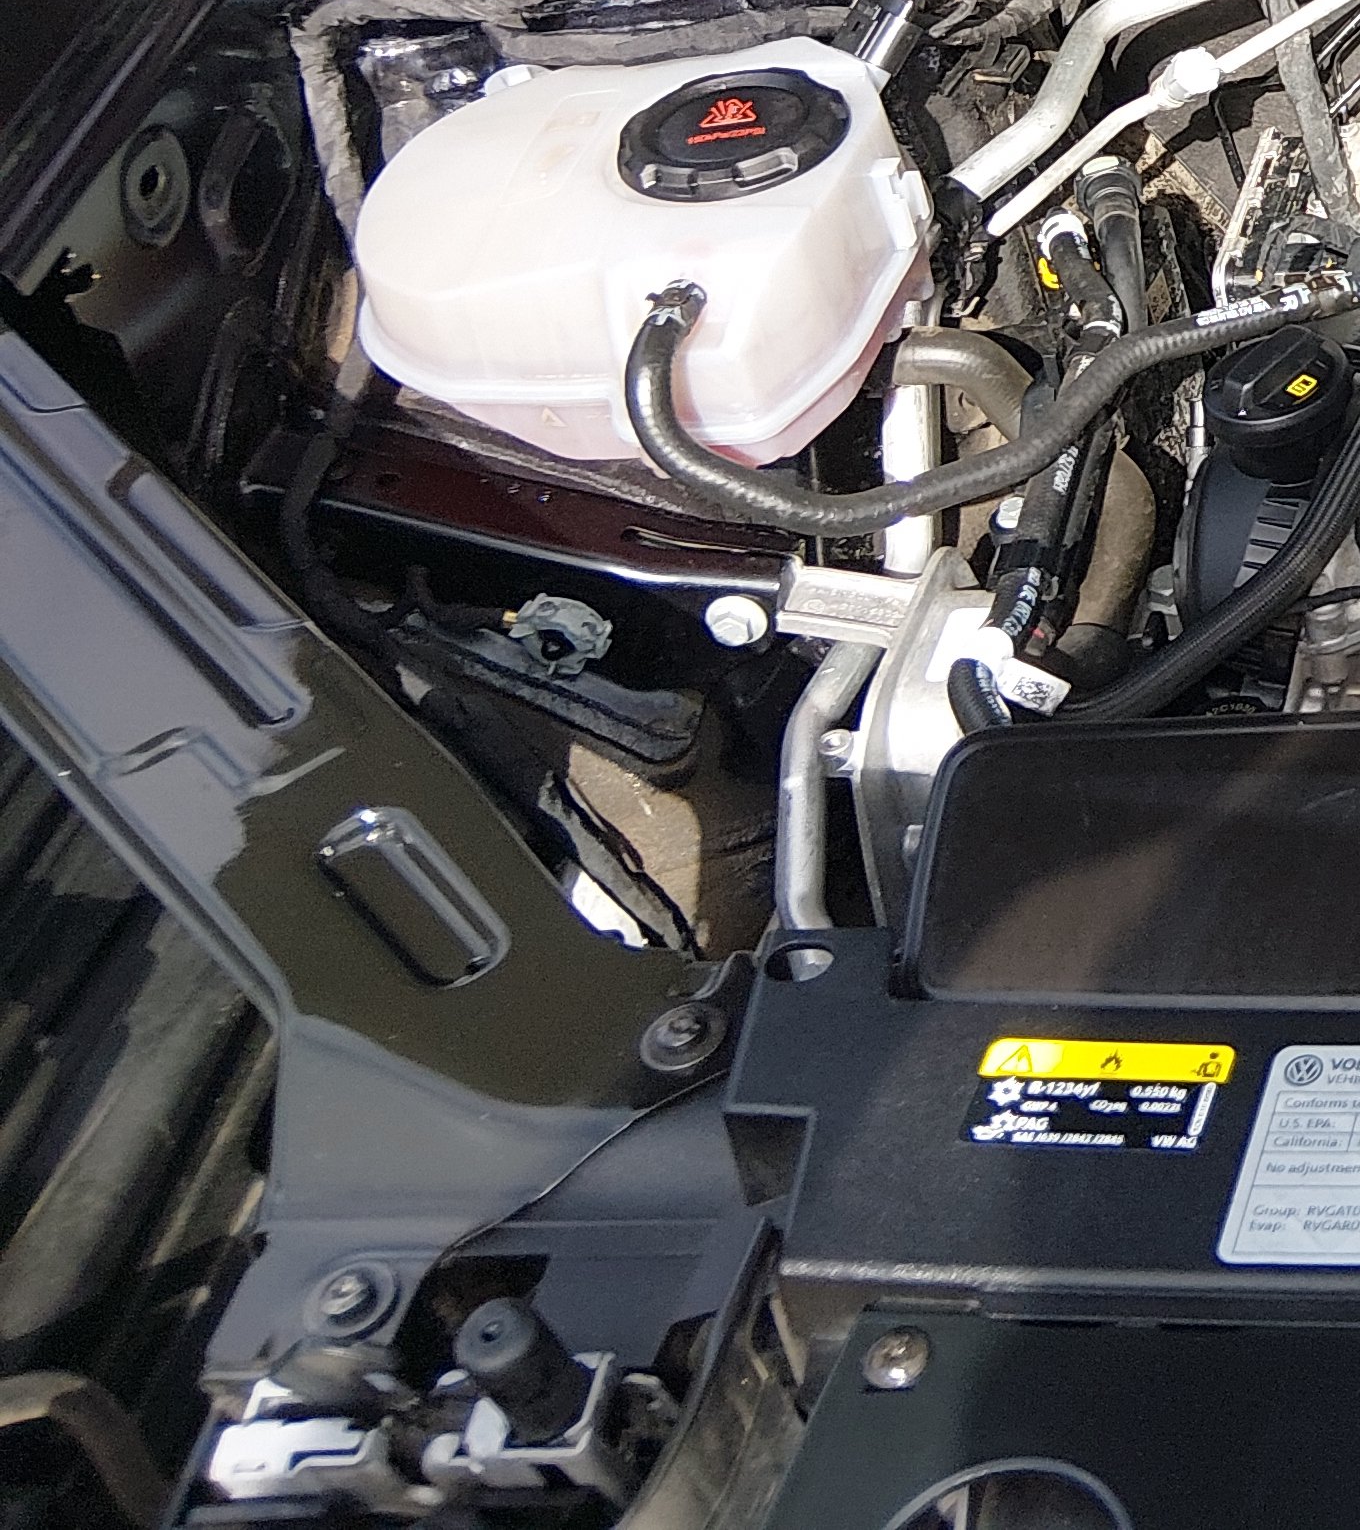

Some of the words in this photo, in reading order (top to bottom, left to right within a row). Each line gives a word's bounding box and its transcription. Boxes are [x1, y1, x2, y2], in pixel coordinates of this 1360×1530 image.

[1285, 1098, 1348, 1109] Conforms
[1014, 1116, 1049, 1130] PAG
[1266, 1162, 1285, 1173] No
[1253, 1205, 1299, 1217] Group:
